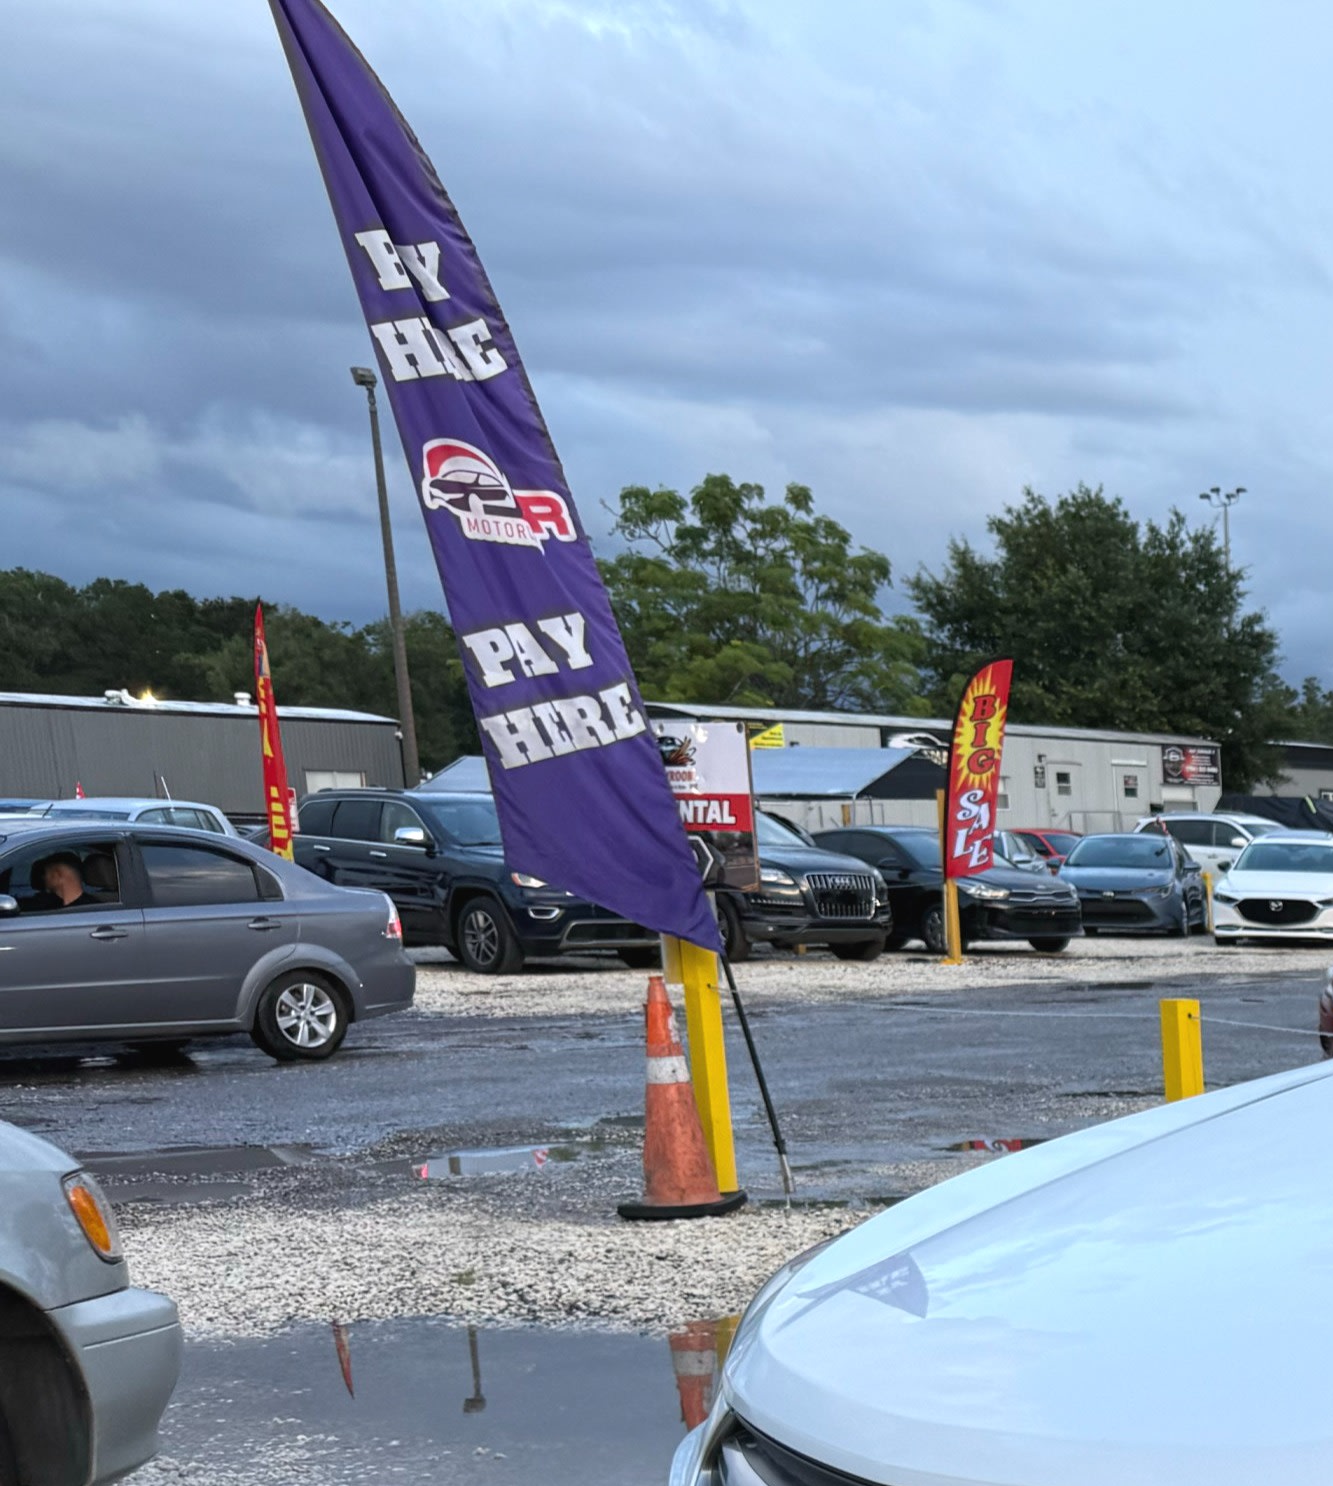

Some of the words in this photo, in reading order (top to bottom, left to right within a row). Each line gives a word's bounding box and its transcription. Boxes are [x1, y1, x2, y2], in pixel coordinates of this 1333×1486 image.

[462, 612, 594, 688] PAY
[480, 682, 647, 770] HERE
[967, 694, 998, 775] BIG
[953, 788, 992, 869] SALE
